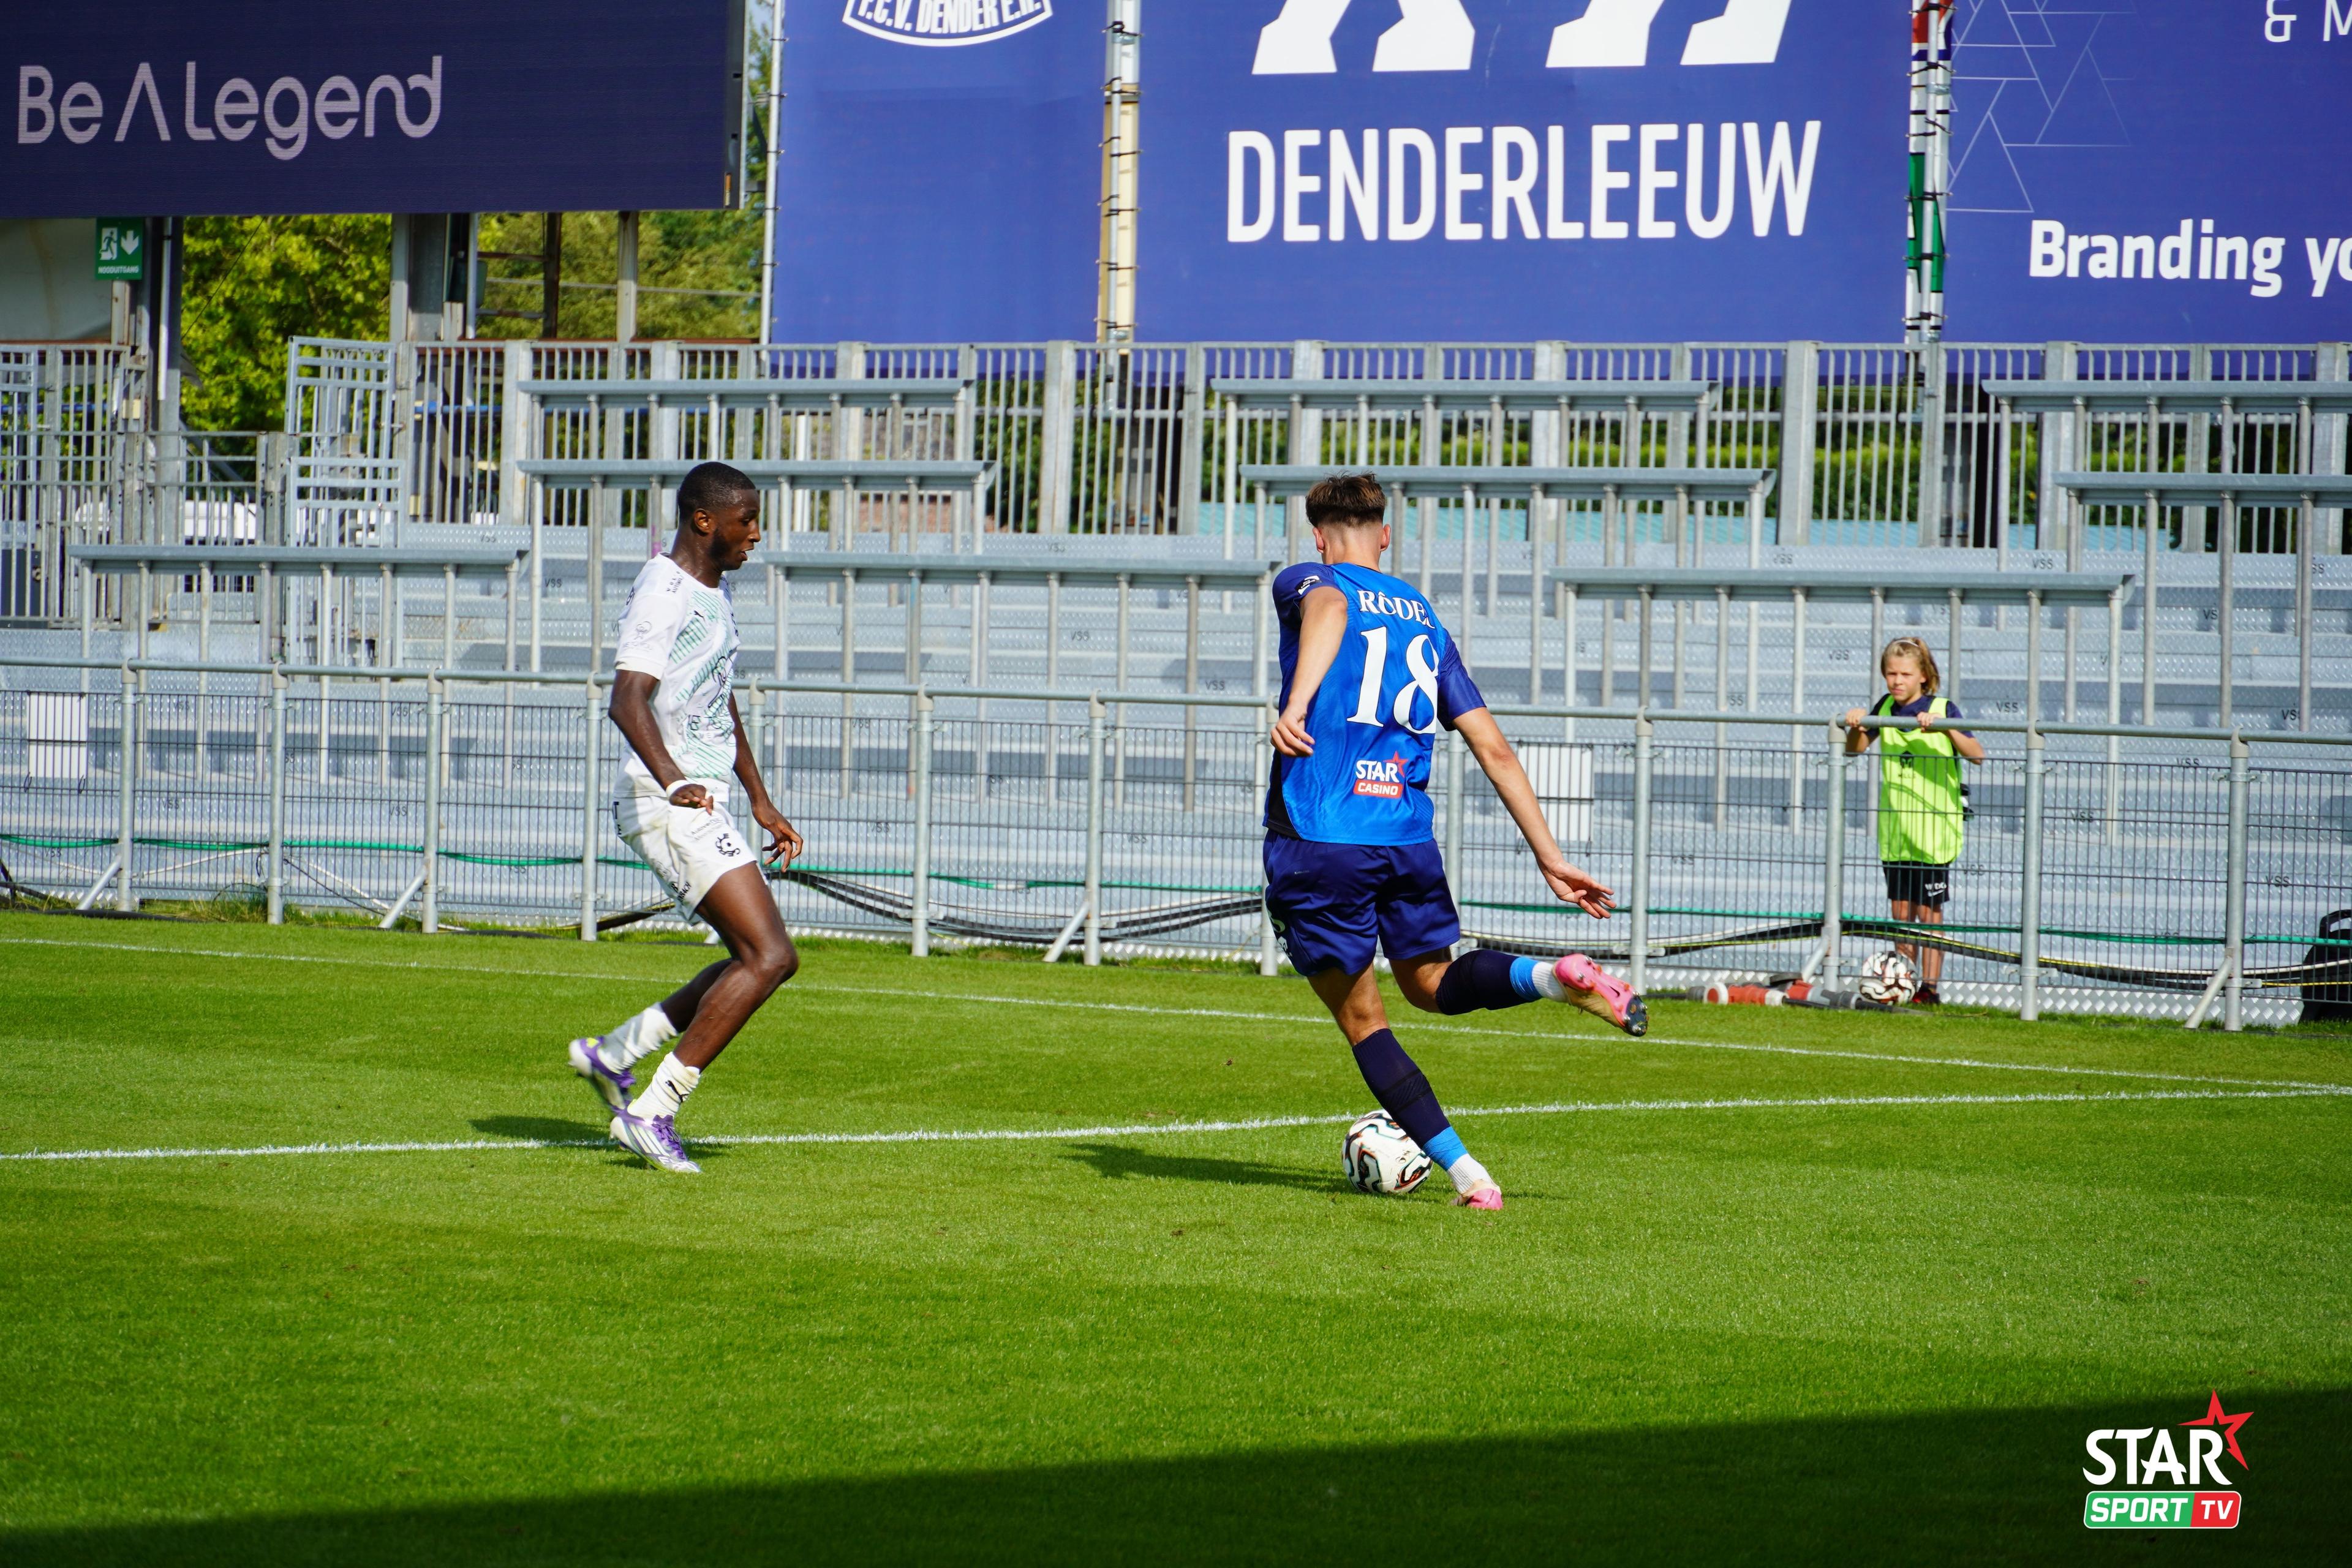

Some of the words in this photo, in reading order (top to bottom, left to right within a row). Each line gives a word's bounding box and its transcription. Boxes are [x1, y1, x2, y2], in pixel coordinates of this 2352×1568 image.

[916, 0, 999, 34] DENDER
[17, 66, 103, 144] Be
[185, 55, 443, 160] Legend
[1227, 121, 1821, 243] DENDERLEEUW
[2029, 219, 2285, 297] Branding
[2032, 559, 2052, 569] VSS
[545, 579, 562, 588] VSS
[1205, 680, 1225, 690] VSS
[1347, 626, 1439, 734] 18
[1996, 703, 2018, 712] VSS
[1355, 760, 1400, 783] STAR
[1357, 782, 1399, 796] CASINO
